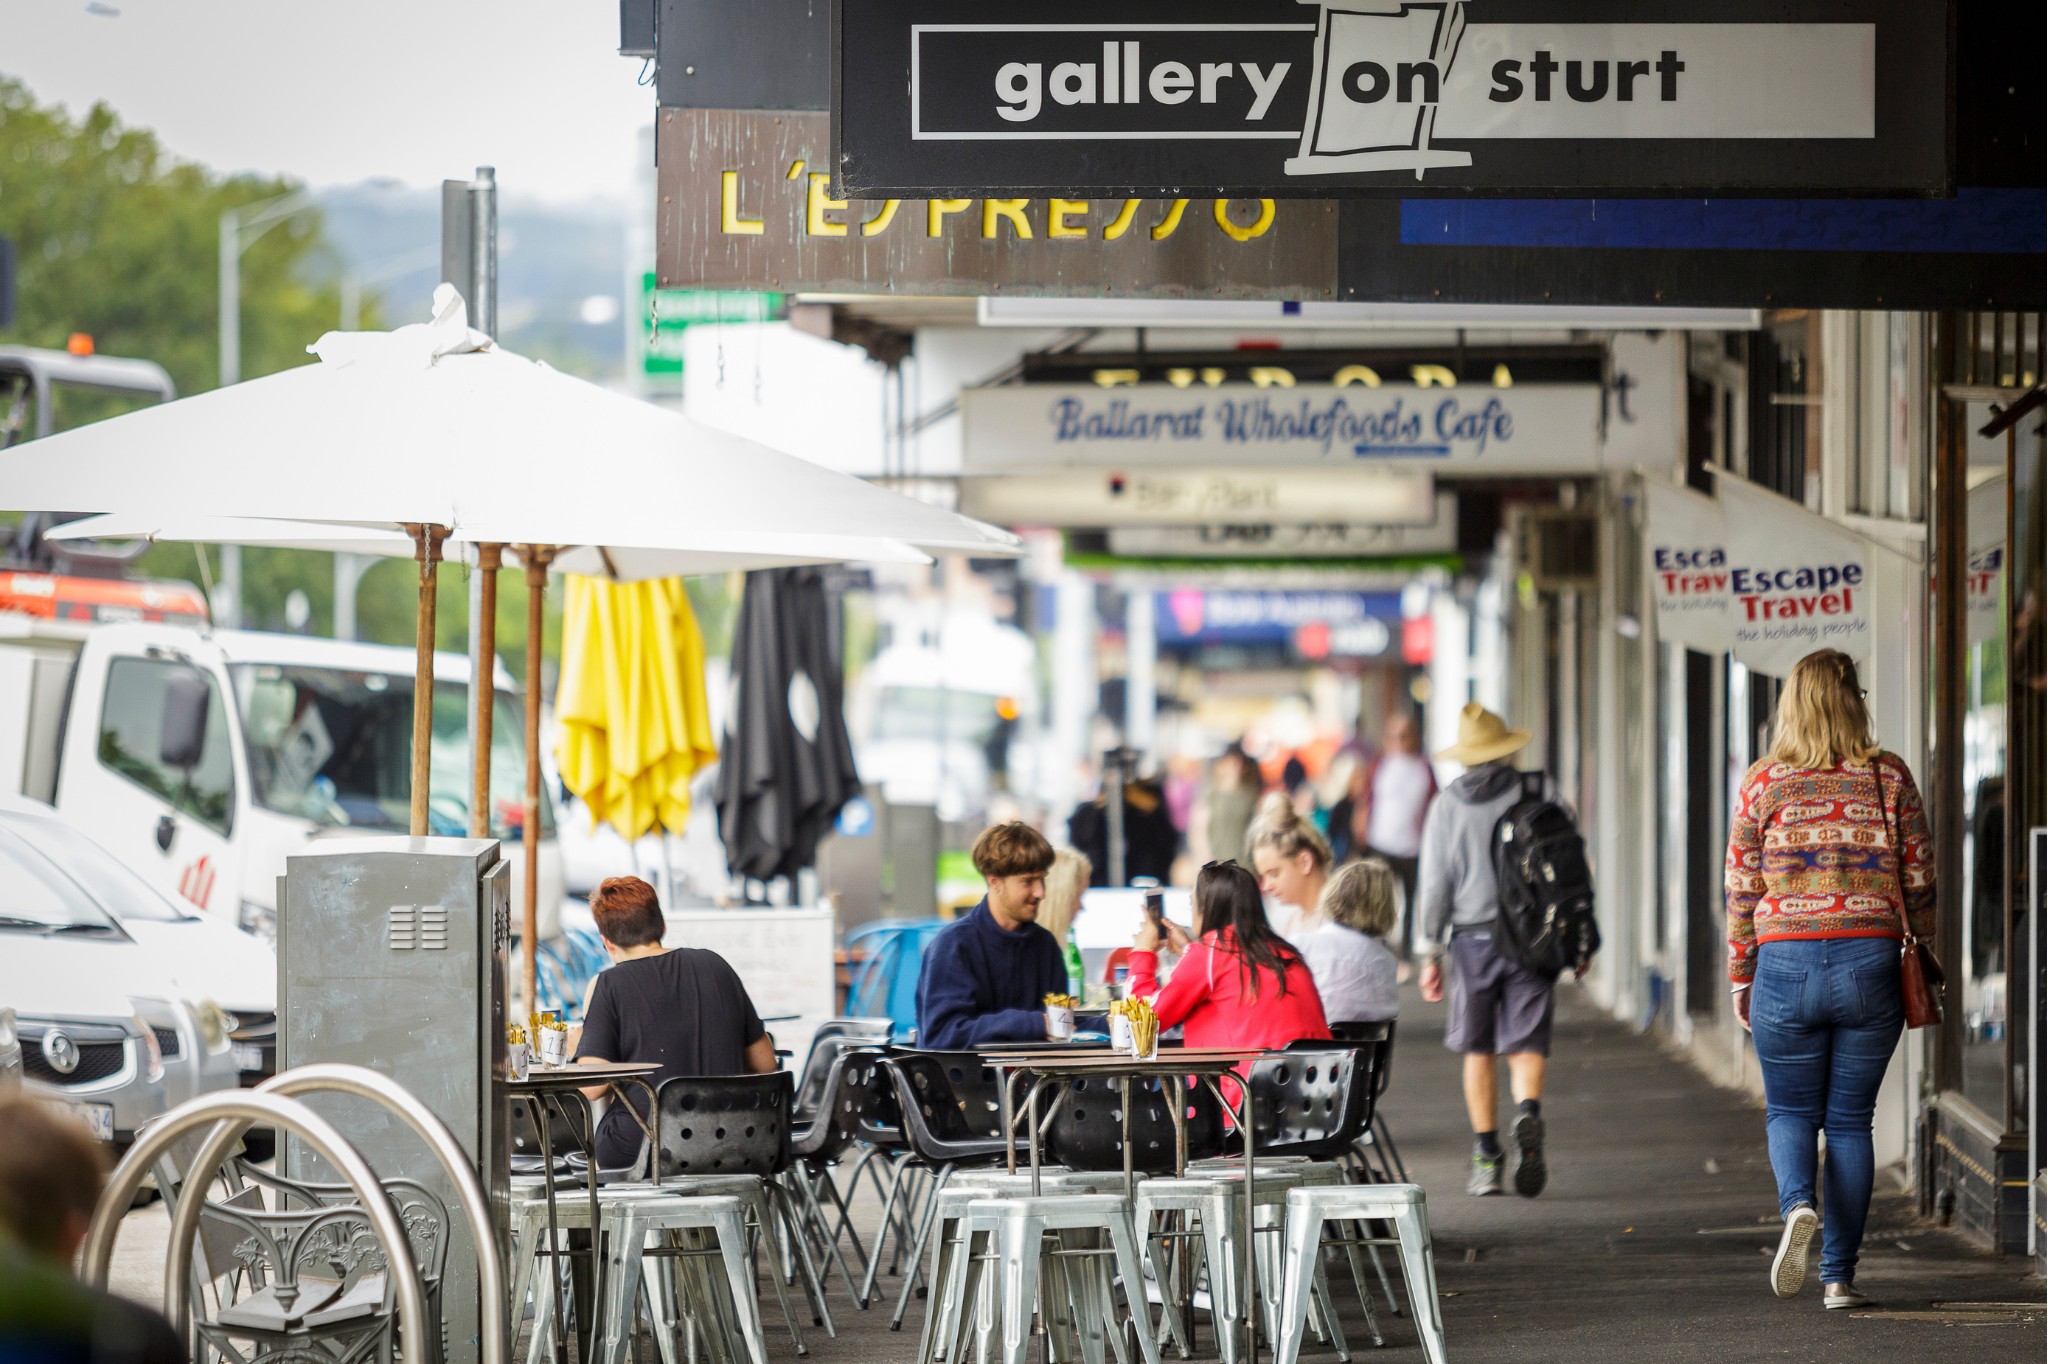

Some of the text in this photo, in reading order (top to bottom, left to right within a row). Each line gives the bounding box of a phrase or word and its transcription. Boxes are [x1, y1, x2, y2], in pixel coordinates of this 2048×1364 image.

[994, 40, 1685, 122] gallery on sturt
[1050, 395, 1514, 456] Ballarat Wholefoods Cafe
[1654, 547, 1726, 571] Esca
[1661, 571, 1729, 596] Trav
[1731, 563, 1863, 594] Escape
[1740, 586, 1853, 621] Travel
[1737, 617, 1868, 642] the holiday people
